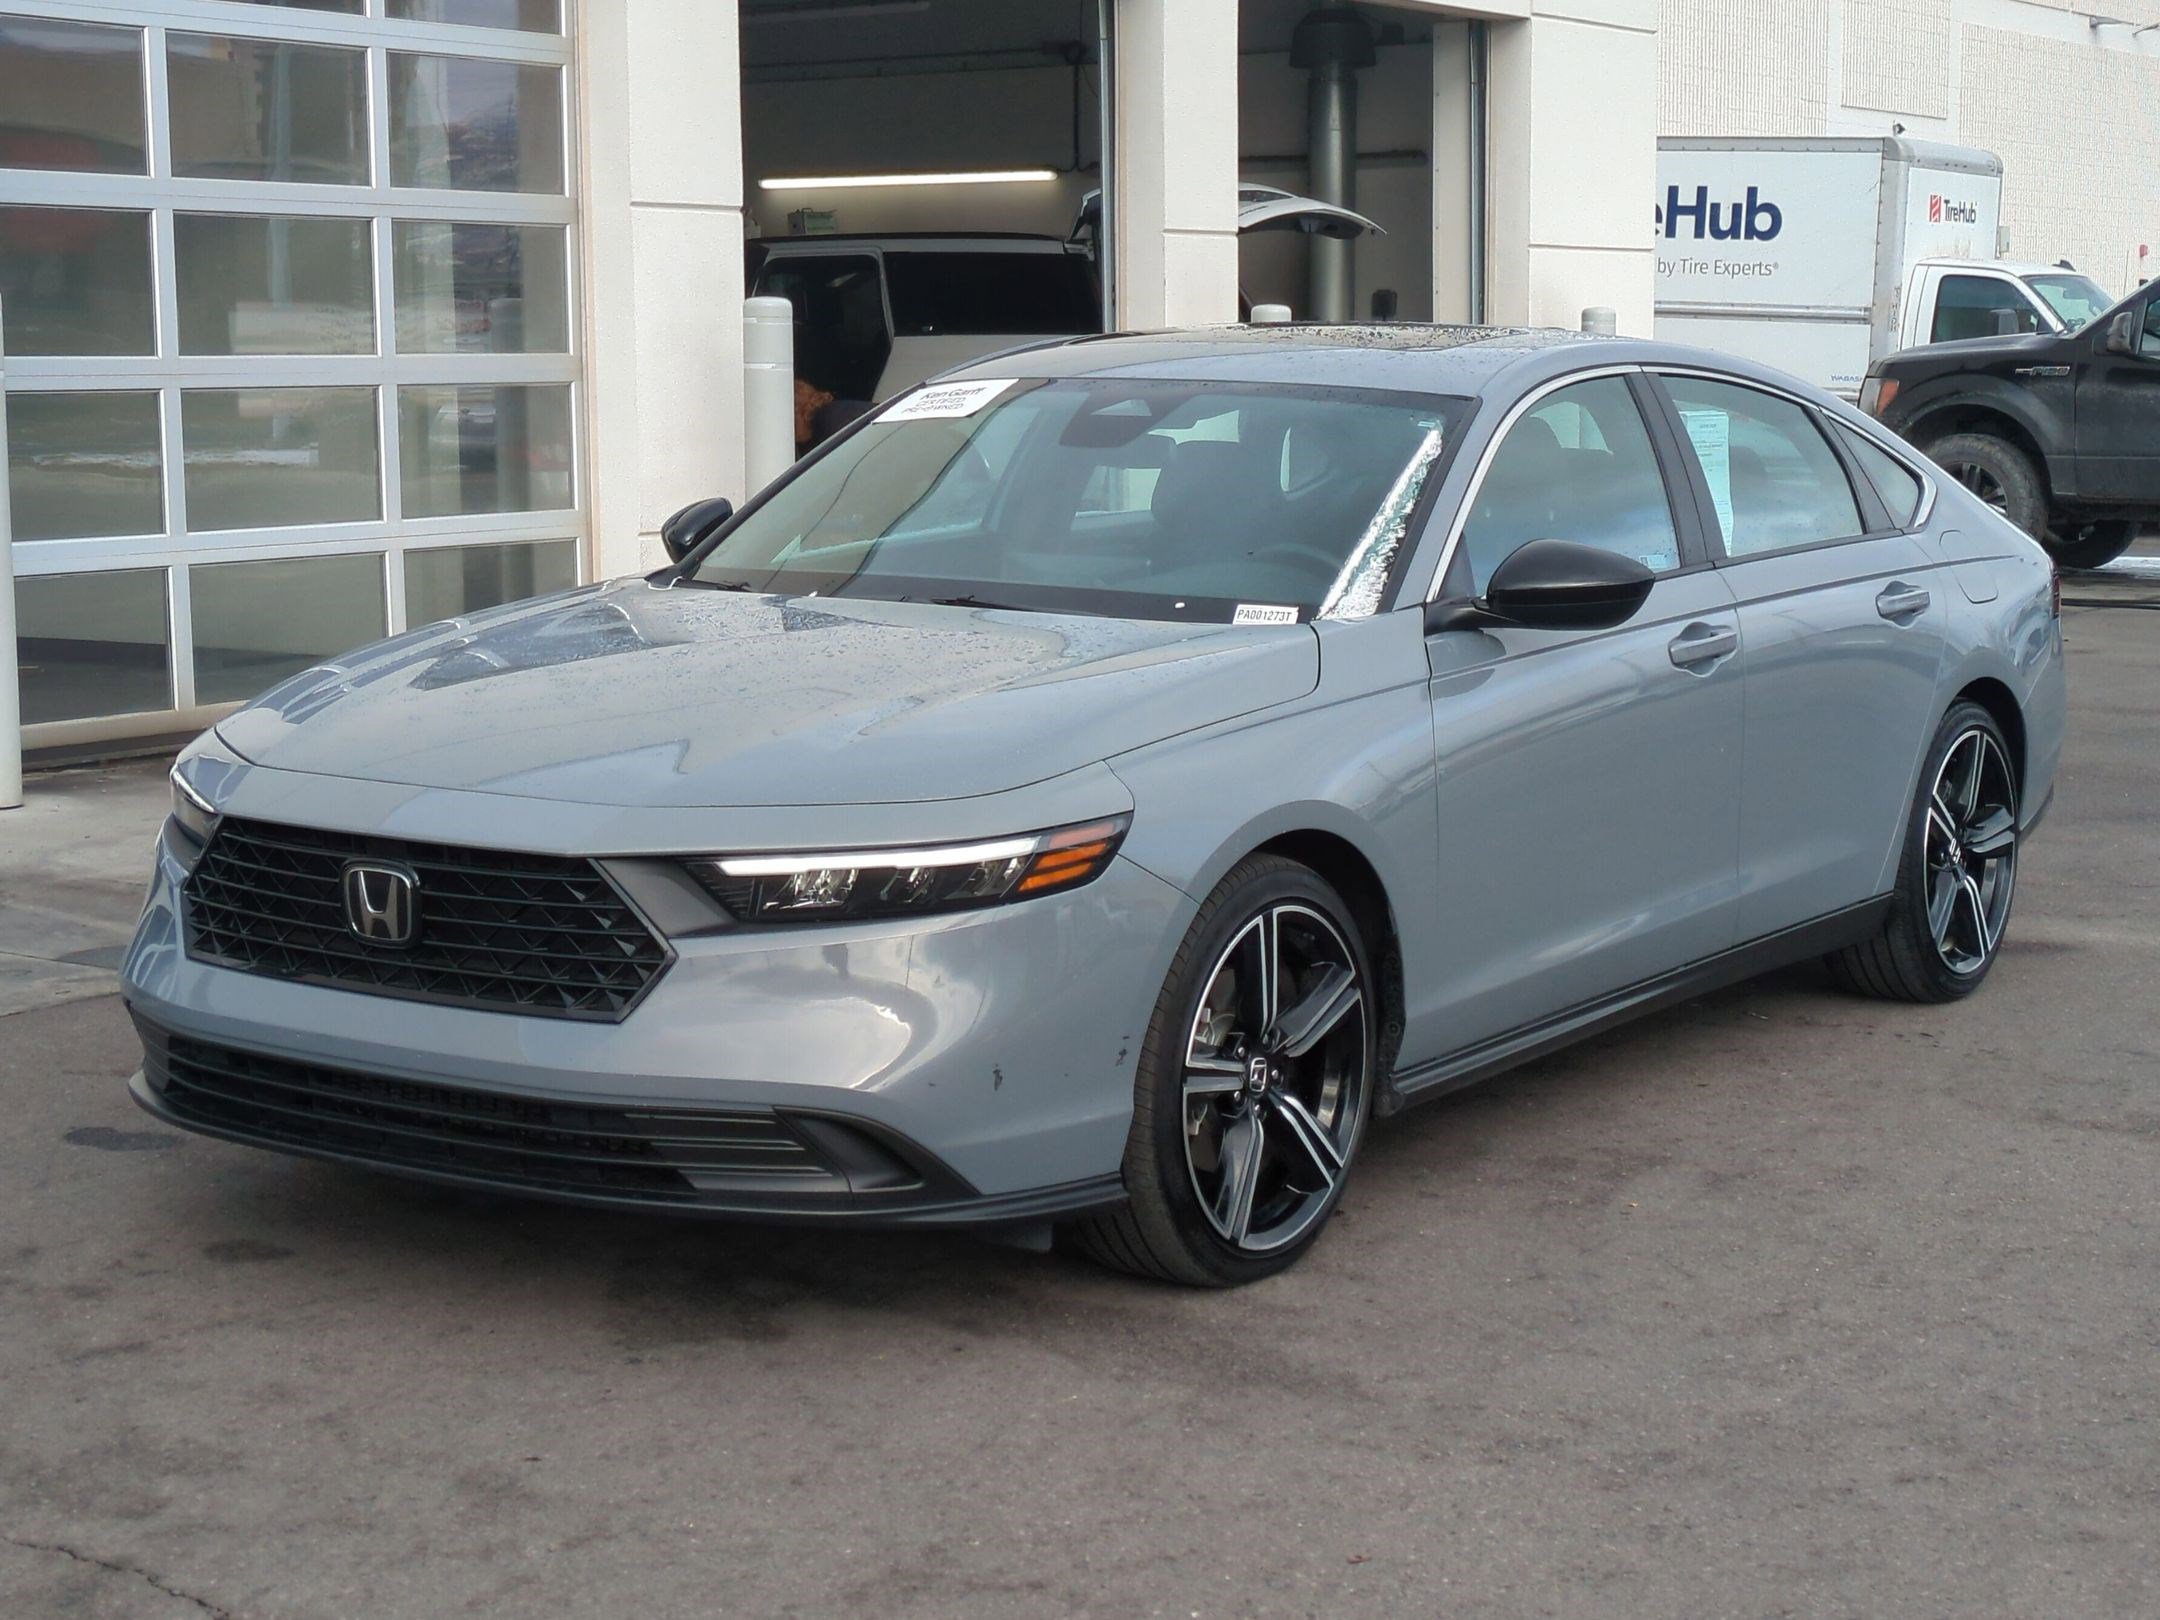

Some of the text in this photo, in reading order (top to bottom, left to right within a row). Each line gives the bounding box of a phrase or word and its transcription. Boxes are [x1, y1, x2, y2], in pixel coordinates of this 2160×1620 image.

[1654, 185, 1782, 241] Hub
[1944, 199, 1976, 224] TireHub
[1657, 257, 1676, 278] by
[1680, 257, 1708, 275] Tire
[1236, 609, 1292, 621] PA001273T
